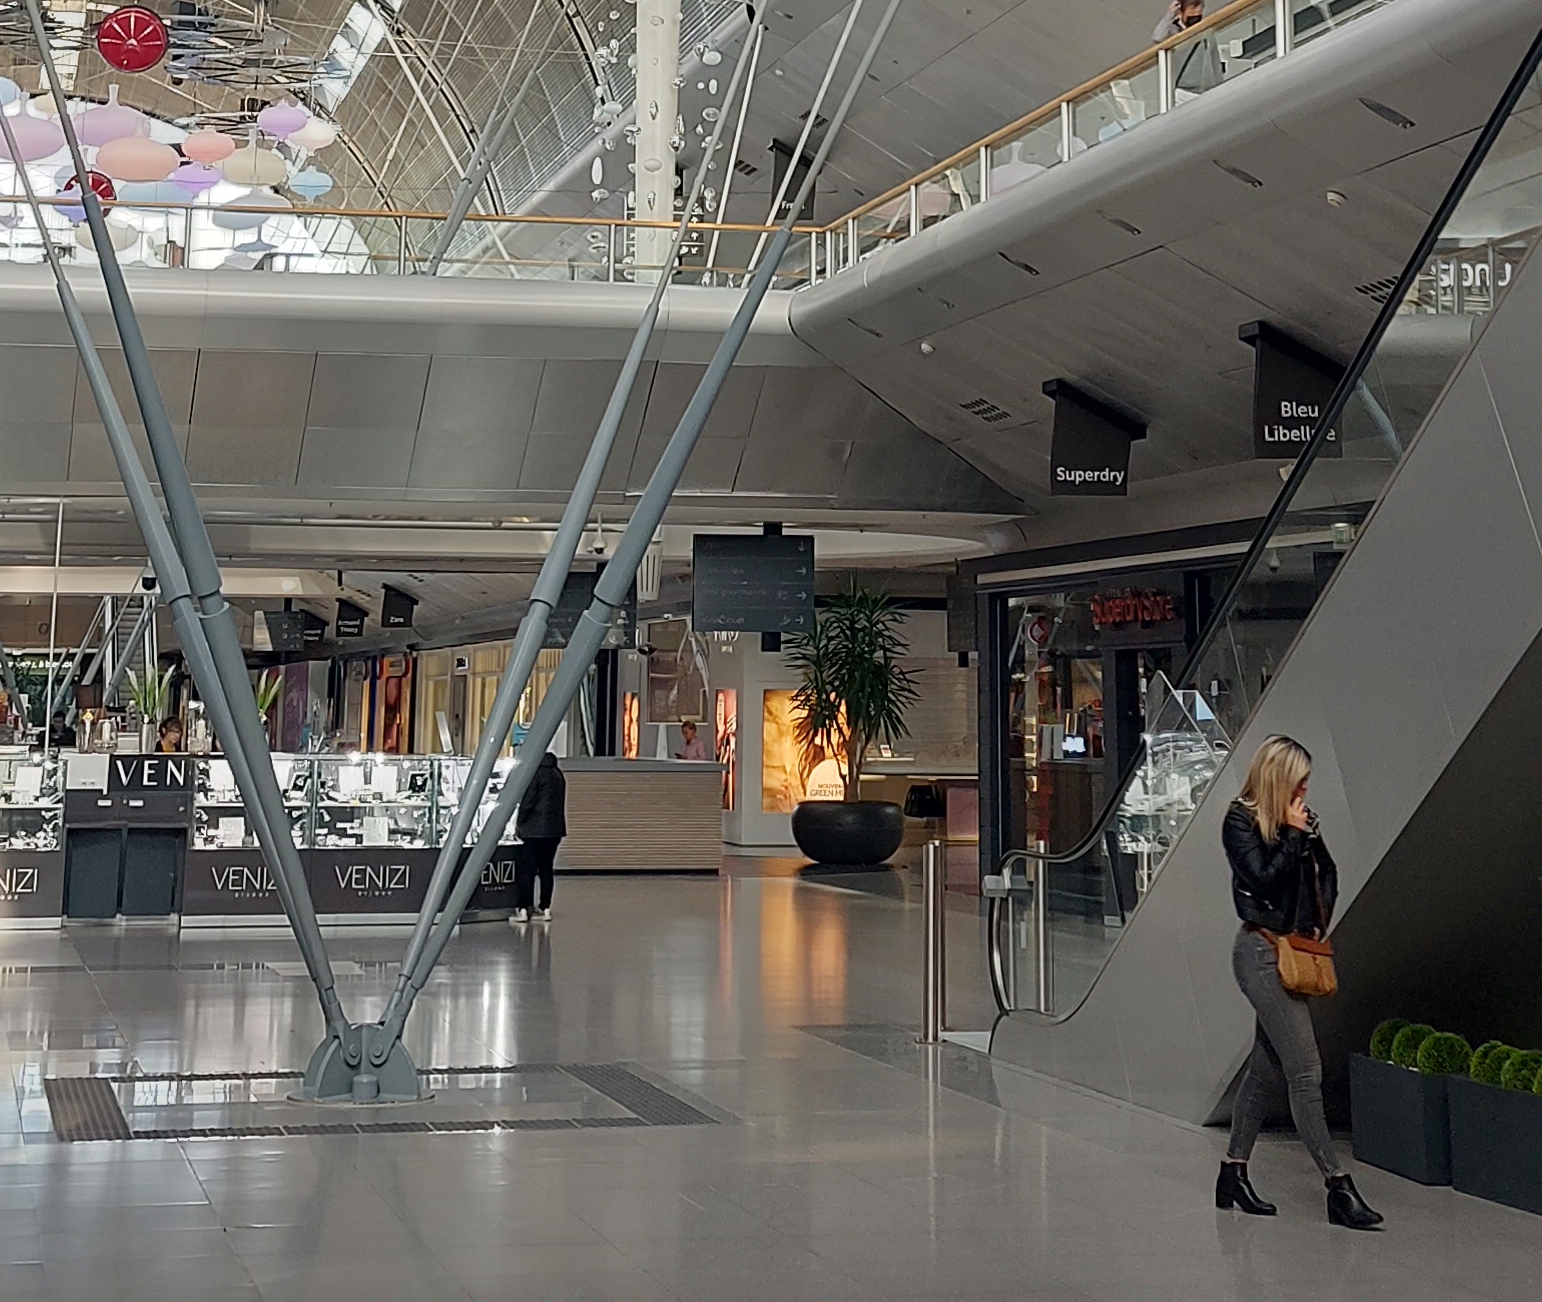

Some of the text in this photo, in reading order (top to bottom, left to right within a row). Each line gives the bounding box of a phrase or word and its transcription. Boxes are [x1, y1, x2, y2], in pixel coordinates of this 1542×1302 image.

[1280, 401, 1319, 418] Bleu
[1264, 425, 1336, 442] Libelle
[1056, 467, 1125, 486] Superdry
[115, 759, 185, 787] VEN
[211, 866, 278, 891] VENI
[334, 864, 410, 890] VENIZI
[481, 860, 515, 885] ENIZI
